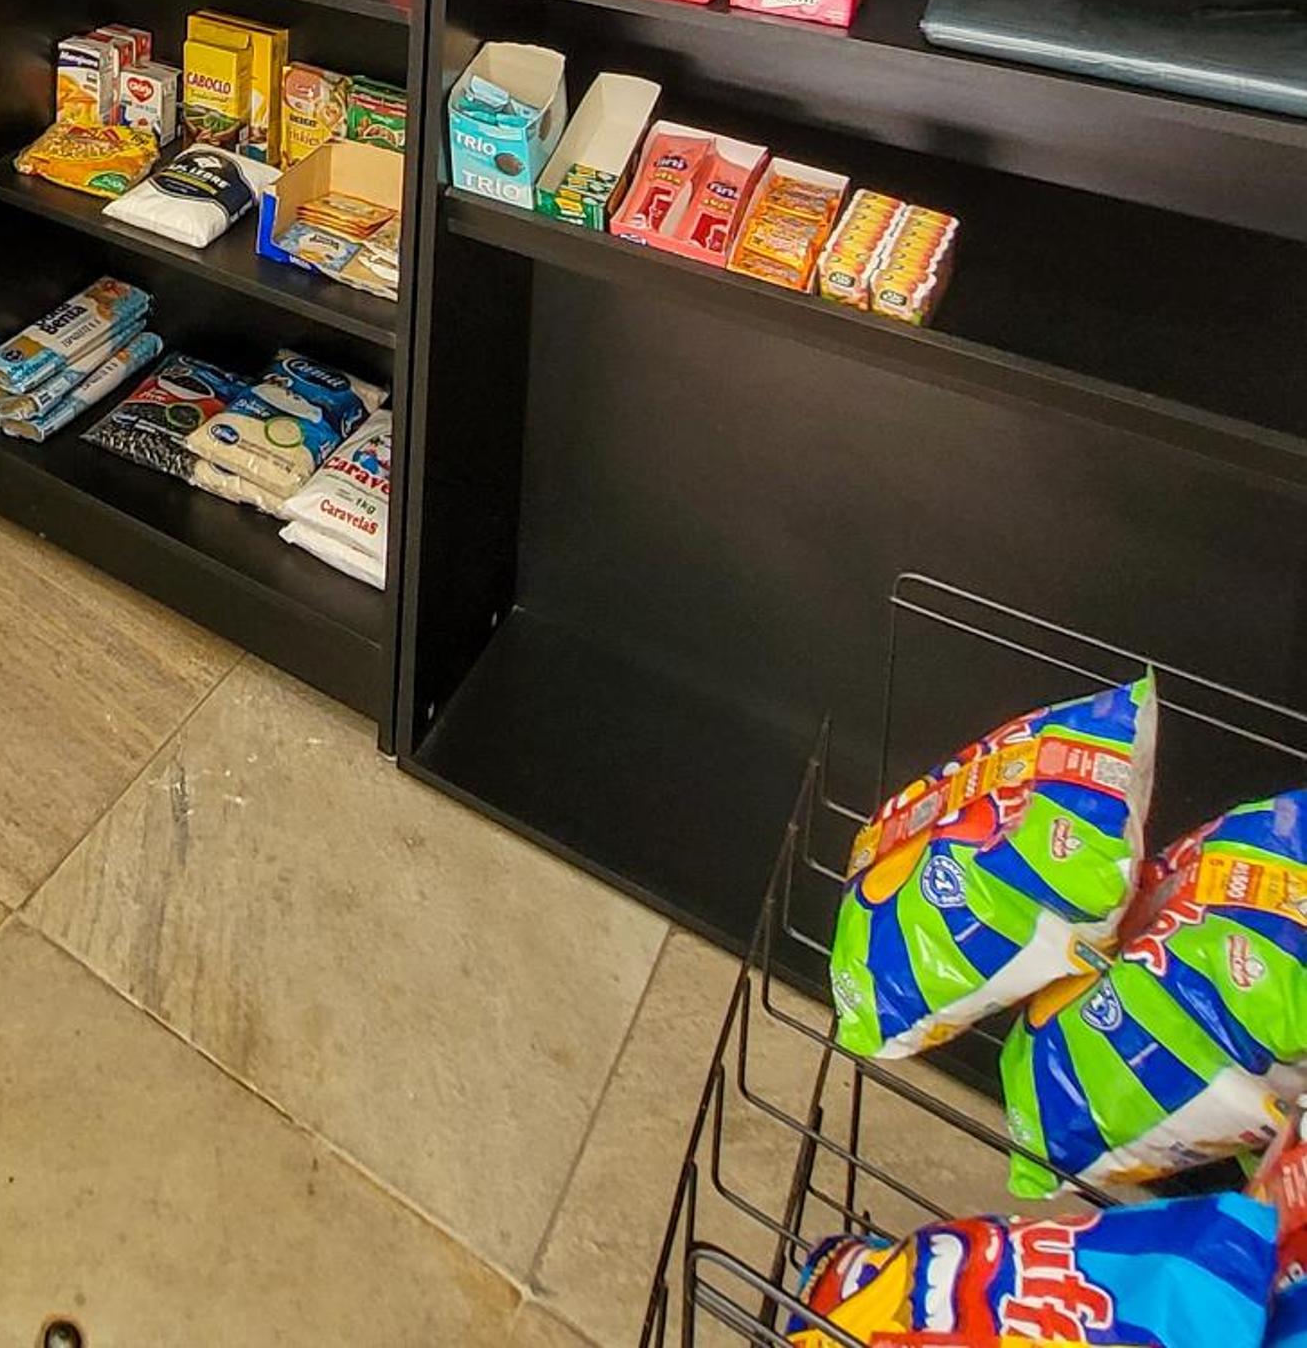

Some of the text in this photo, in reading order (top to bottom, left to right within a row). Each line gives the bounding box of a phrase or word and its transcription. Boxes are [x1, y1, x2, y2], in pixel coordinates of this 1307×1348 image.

[187, 72, 231, 94] CABOCLO
[455, 130, 496, 155] TRIO
[462, 169, 520, 199] TRIO
[320, 499, 379, 536] Caravelas
[356, 497, 377, 516] 1kg
